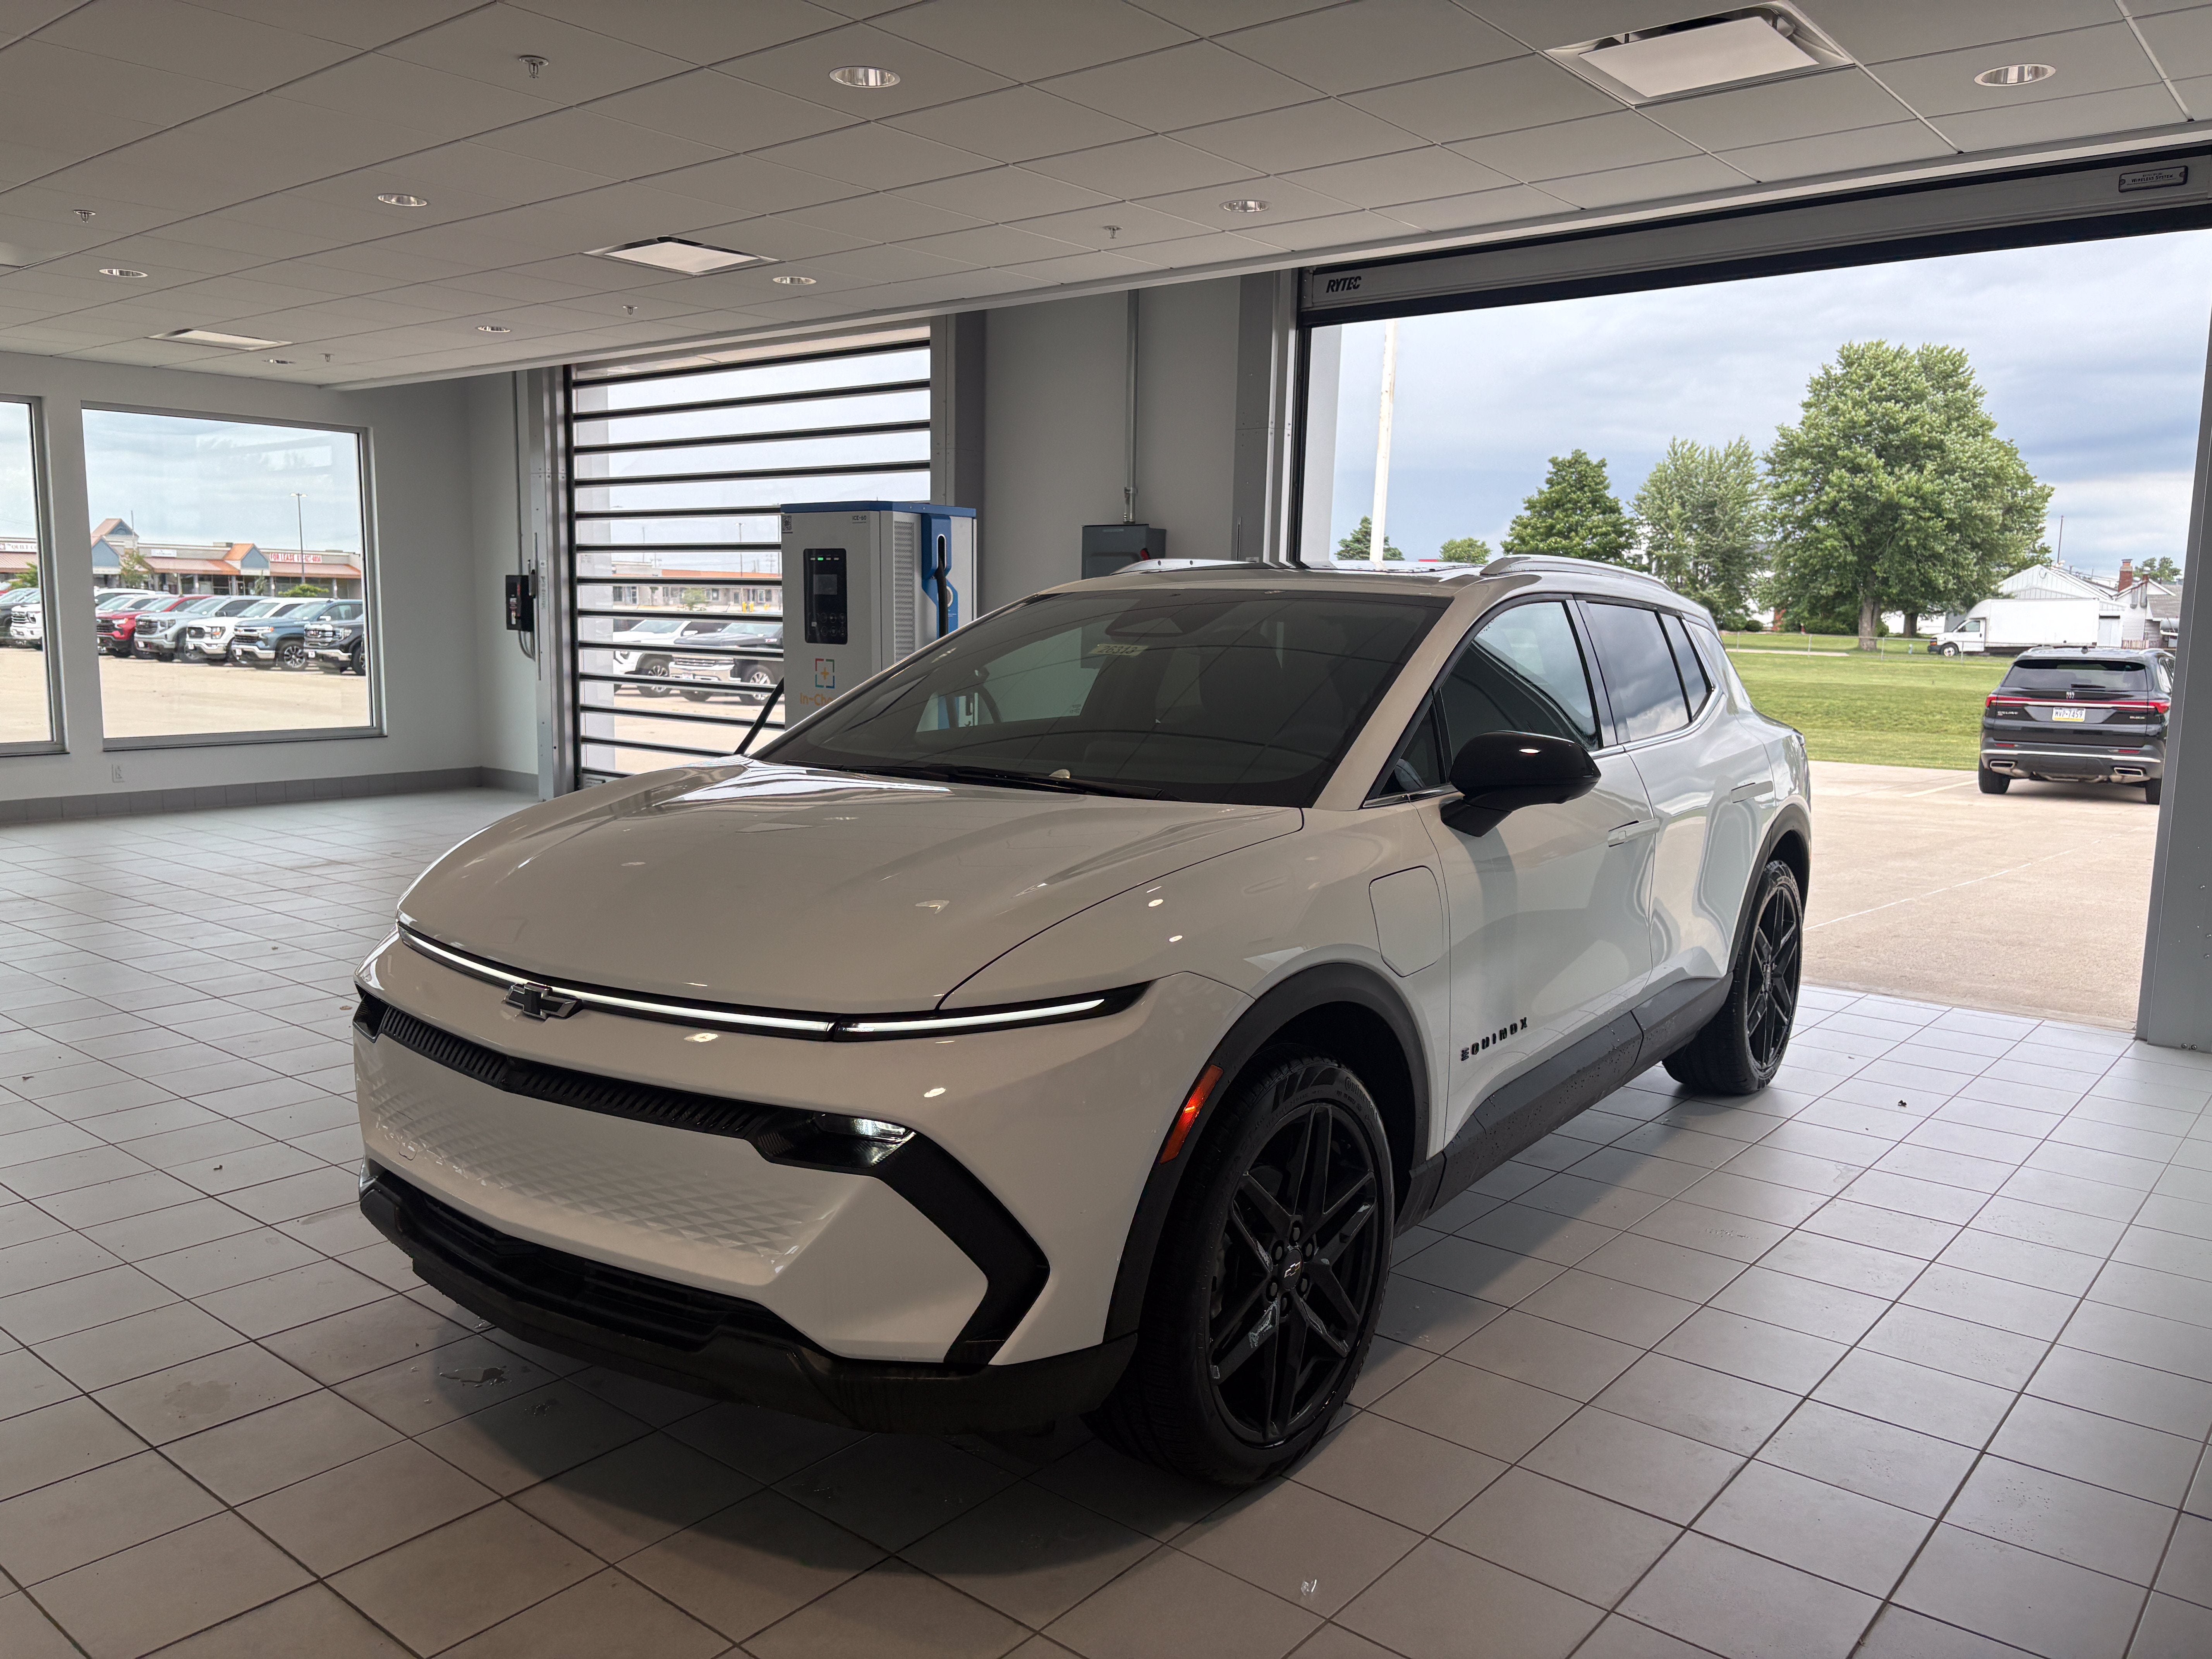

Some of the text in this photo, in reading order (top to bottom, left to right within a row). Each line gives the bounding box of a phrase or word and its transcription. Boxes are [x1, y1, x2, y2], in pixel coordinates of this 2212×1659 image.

[1326, 276, 1362, 293] RYTEC
[1097, 646, 1138, 654] 26313
[1461, 1017, 1528, 1061] EQUINOX
